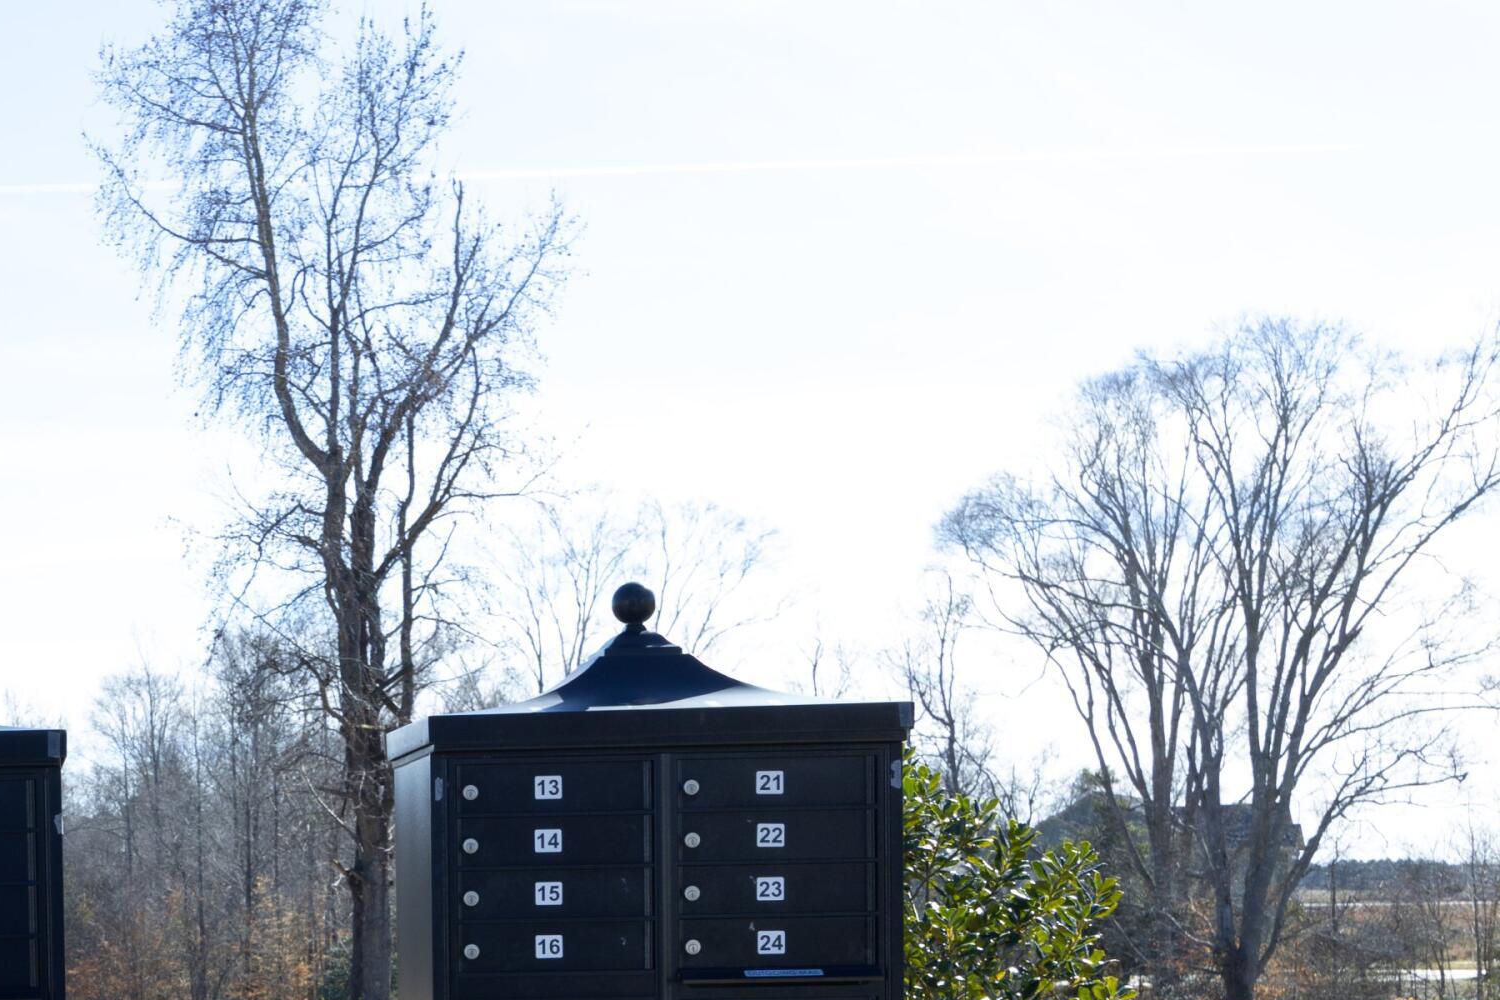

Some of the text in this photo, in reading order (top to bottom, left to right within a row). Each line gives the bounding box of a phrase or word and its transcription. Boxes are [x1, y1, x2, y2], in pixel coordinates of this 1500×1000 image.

[537, 779, 560, 796] 13
[759, 774, 781, 791] 21
[537, 832, 560, 849] 14
[759, 826, 783, 844] 22
[537, 885, 560, 902] 15
[759, 880, 783, 898] 23
[537, 938, 561, 955] 16
[759, 934, 784, 951] 24
